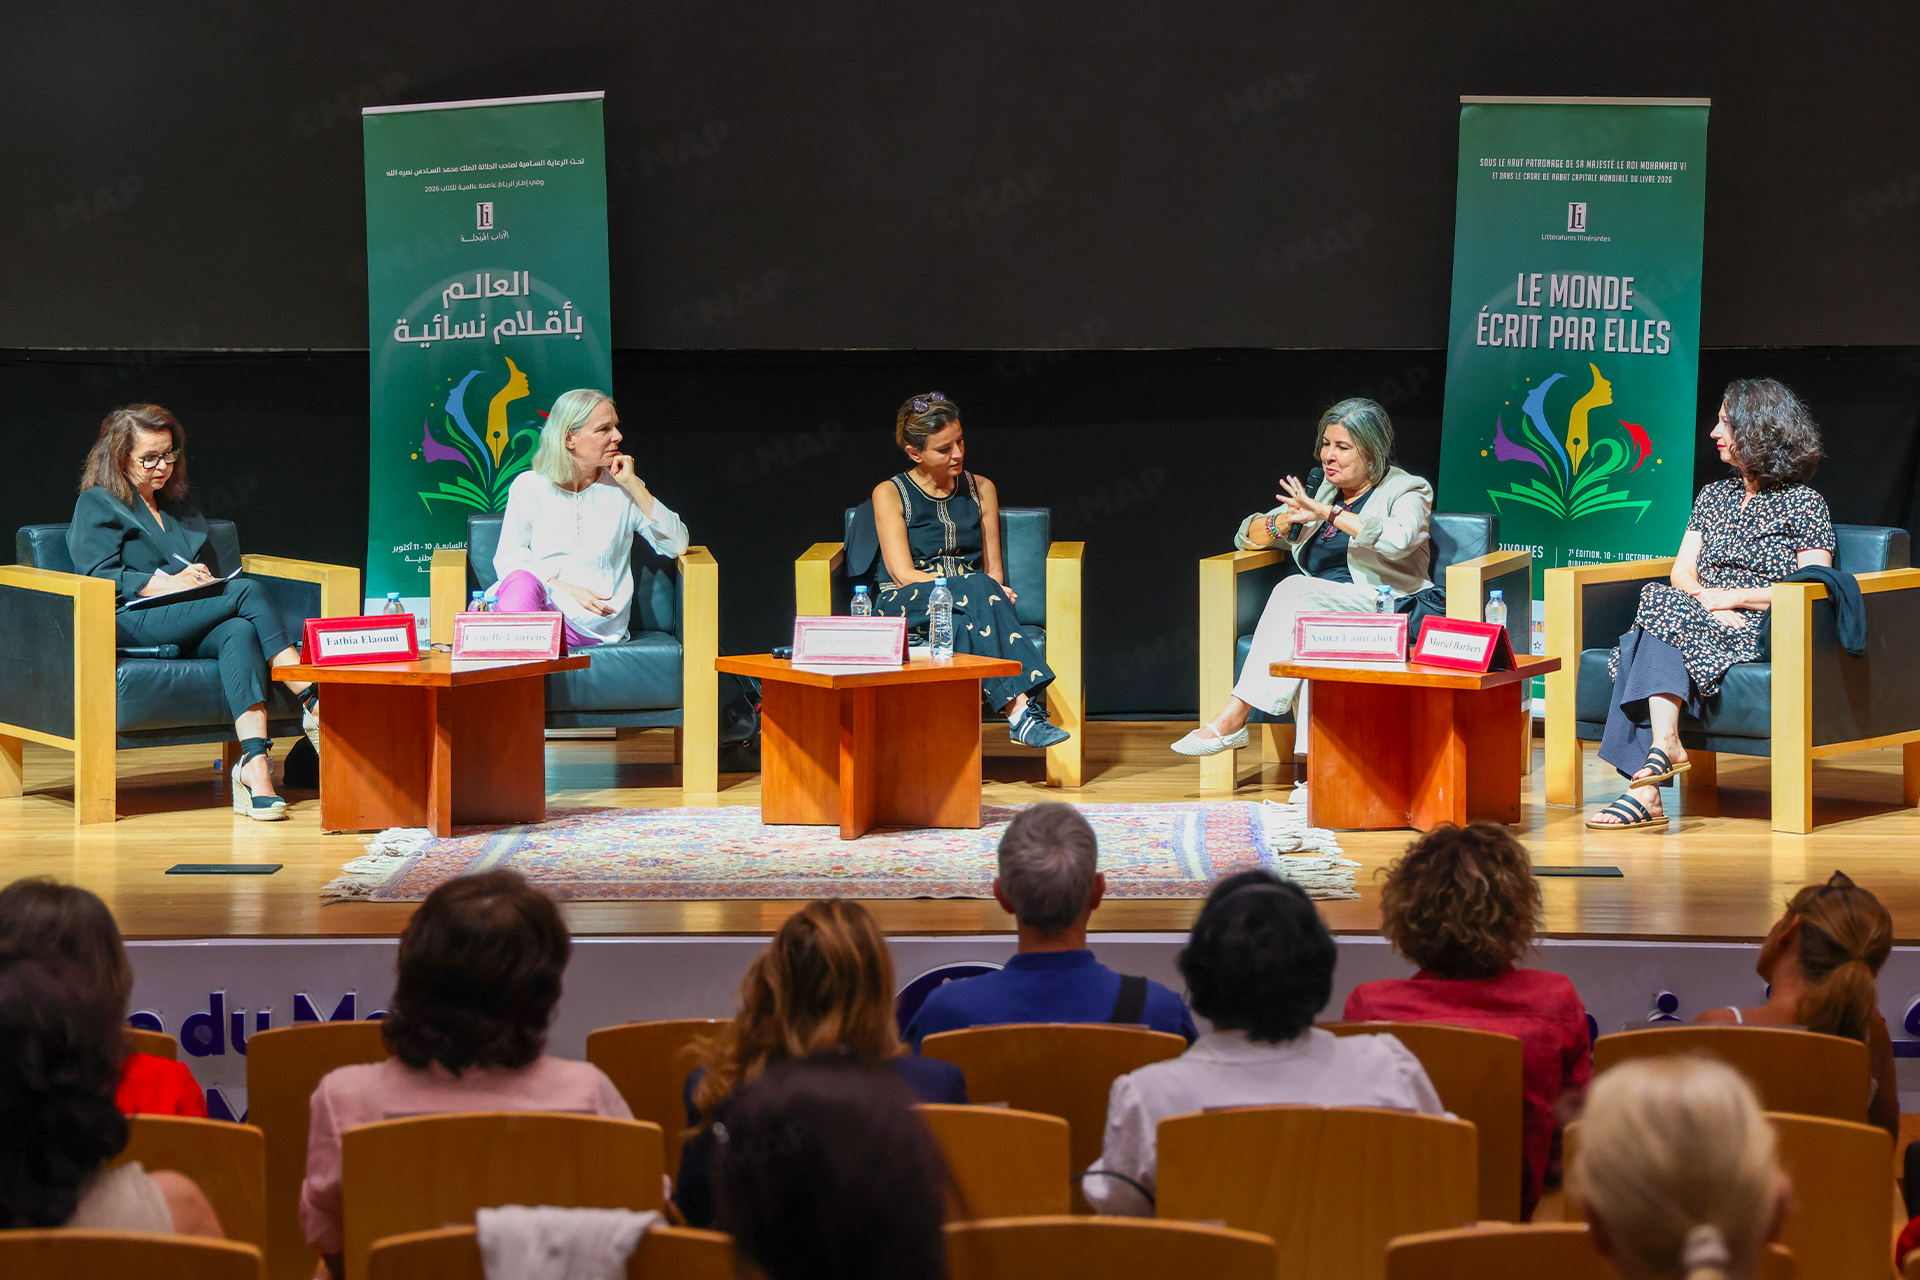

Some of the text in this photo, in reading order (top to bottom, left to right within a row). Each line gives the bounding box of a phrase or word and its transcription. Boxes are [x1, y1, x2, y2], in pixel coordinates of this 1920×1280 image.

[386, 157, 585, 178] تحت الرعاية السامية لصاحب الجلالة الملك محمد السادس نصره الله
[1479, 158, 1687, 171] SOUS LE HAUT PATRONAGE DE SA MAJESTÉ LE ROI MOHAMMED VI
[515, 179, 529, 188] إطار
[529, 179, 545, 187] وفي
[1492, 171, 1673, 184] ET DANS LE CADRE DE RABAT CAPITALE MONDIALE DU LIVRE 2026
[424, 185, 440, 193] 2026
[440, 184, 457, 193] للكتاب
[457, 183, 477, 192] عالمية
[497, 180, 515, 189] الرباط
[1541, 233, 1611, 242] Littératures Itinérantes
[442, 270, 529, 309] العالم
[1516, 272, 1635, 311] LE MONDE
[394, 301, 583, 348] بأقلام نسائية
[1476, 305, 1672, 355] ÉCRIT PAR ELLES
[391, 541, 413, 554] أكتوبر
[424, 542, 433, 550] 10
[1603, 551, 1611, 560] 10
[1617, 552, 1624, 561] 11
[326, 633, 399, 646] Fathia Elaouni
[1311, 633, 1339, 642] Asma
[1430, 636, 1453, 649] Muriel
[180, 989, 273, 1057] du
